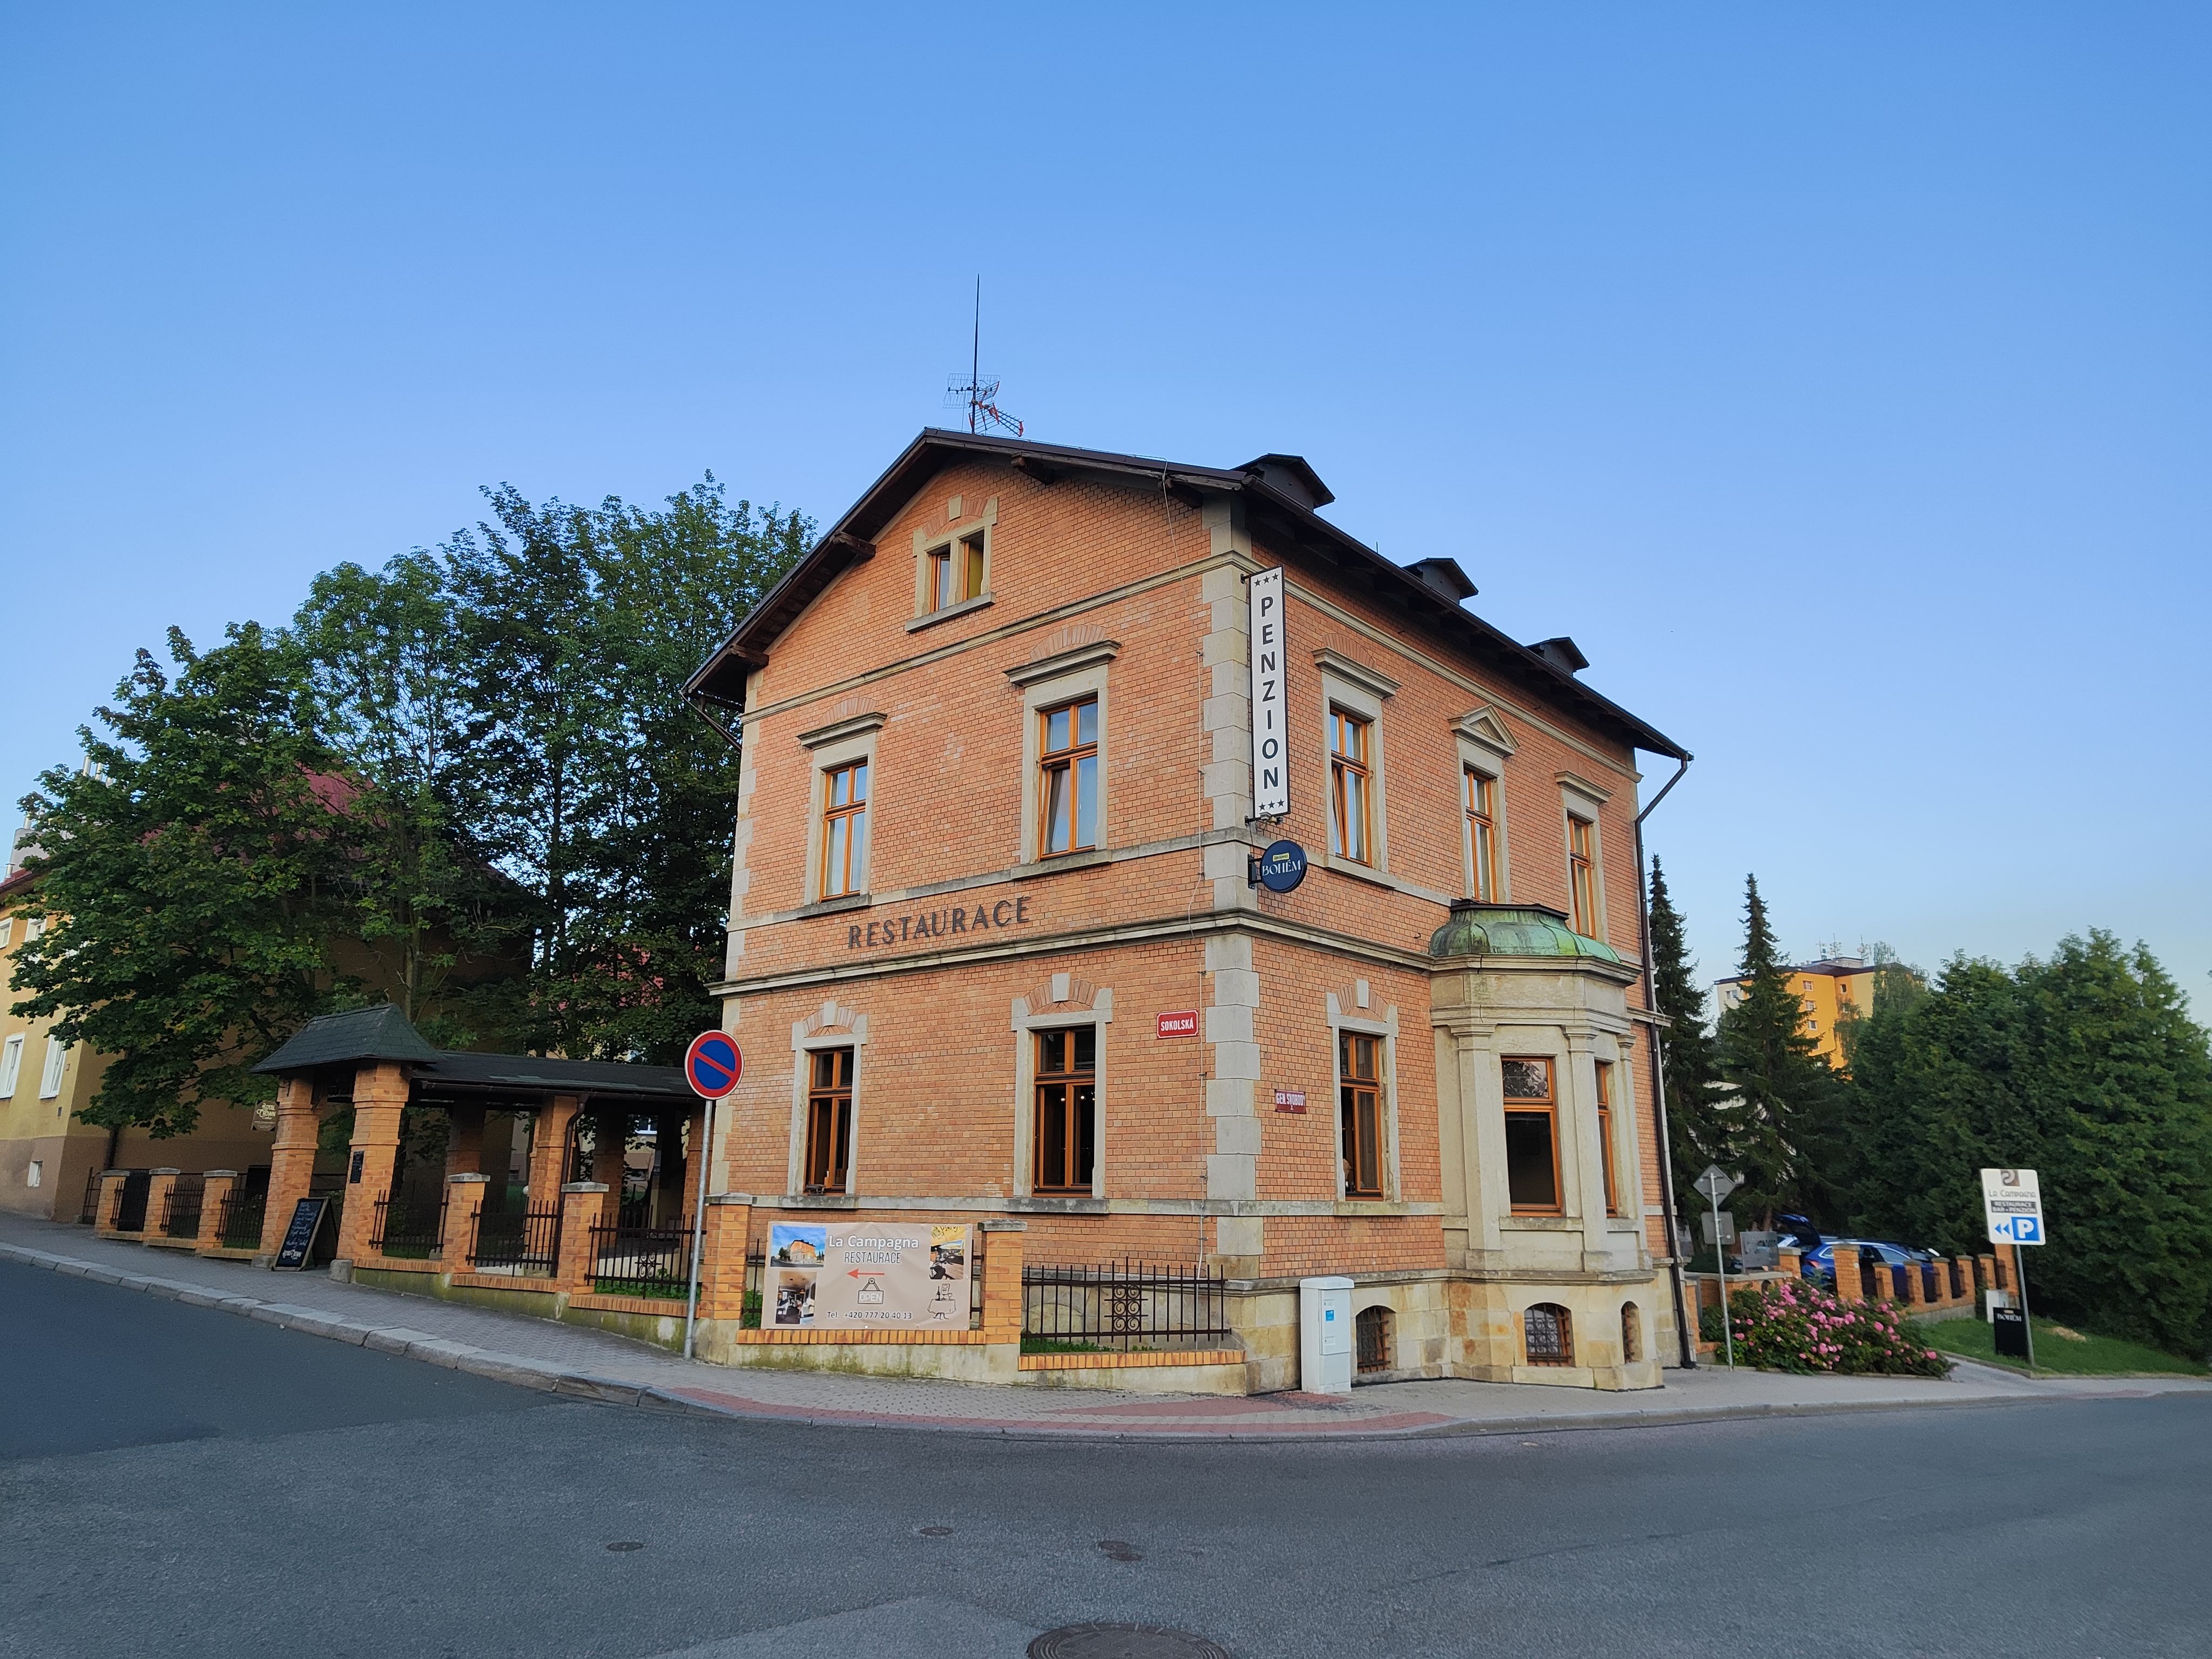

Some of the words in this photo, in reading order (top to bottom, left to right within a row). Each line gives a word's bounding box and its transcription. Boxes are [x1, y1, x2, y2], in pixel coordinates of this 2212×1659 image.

[1260, 596, 1279, 790] PENZION
[1262, 859, 1301, 876] BOHÉM
[848, 895, 1032, 948] RESTAURACE
[1161, 1016, 1194, 1031] SOKOLSKÁ
[1286, 1093, 1305, 1106] SVOBODY
[1988, 1189, 1998, 1197] La
[2000, 1189, 2036, 1198] Campagna
[2017, 1218, 2034, 1239] P
[828, 1235, 844, 1247] La
[847, 1235, 919, 1251] Campagna
[844, 1251, 902, 1264] RESTAURACE
[860, 1293, 882, 1301] OPEN
